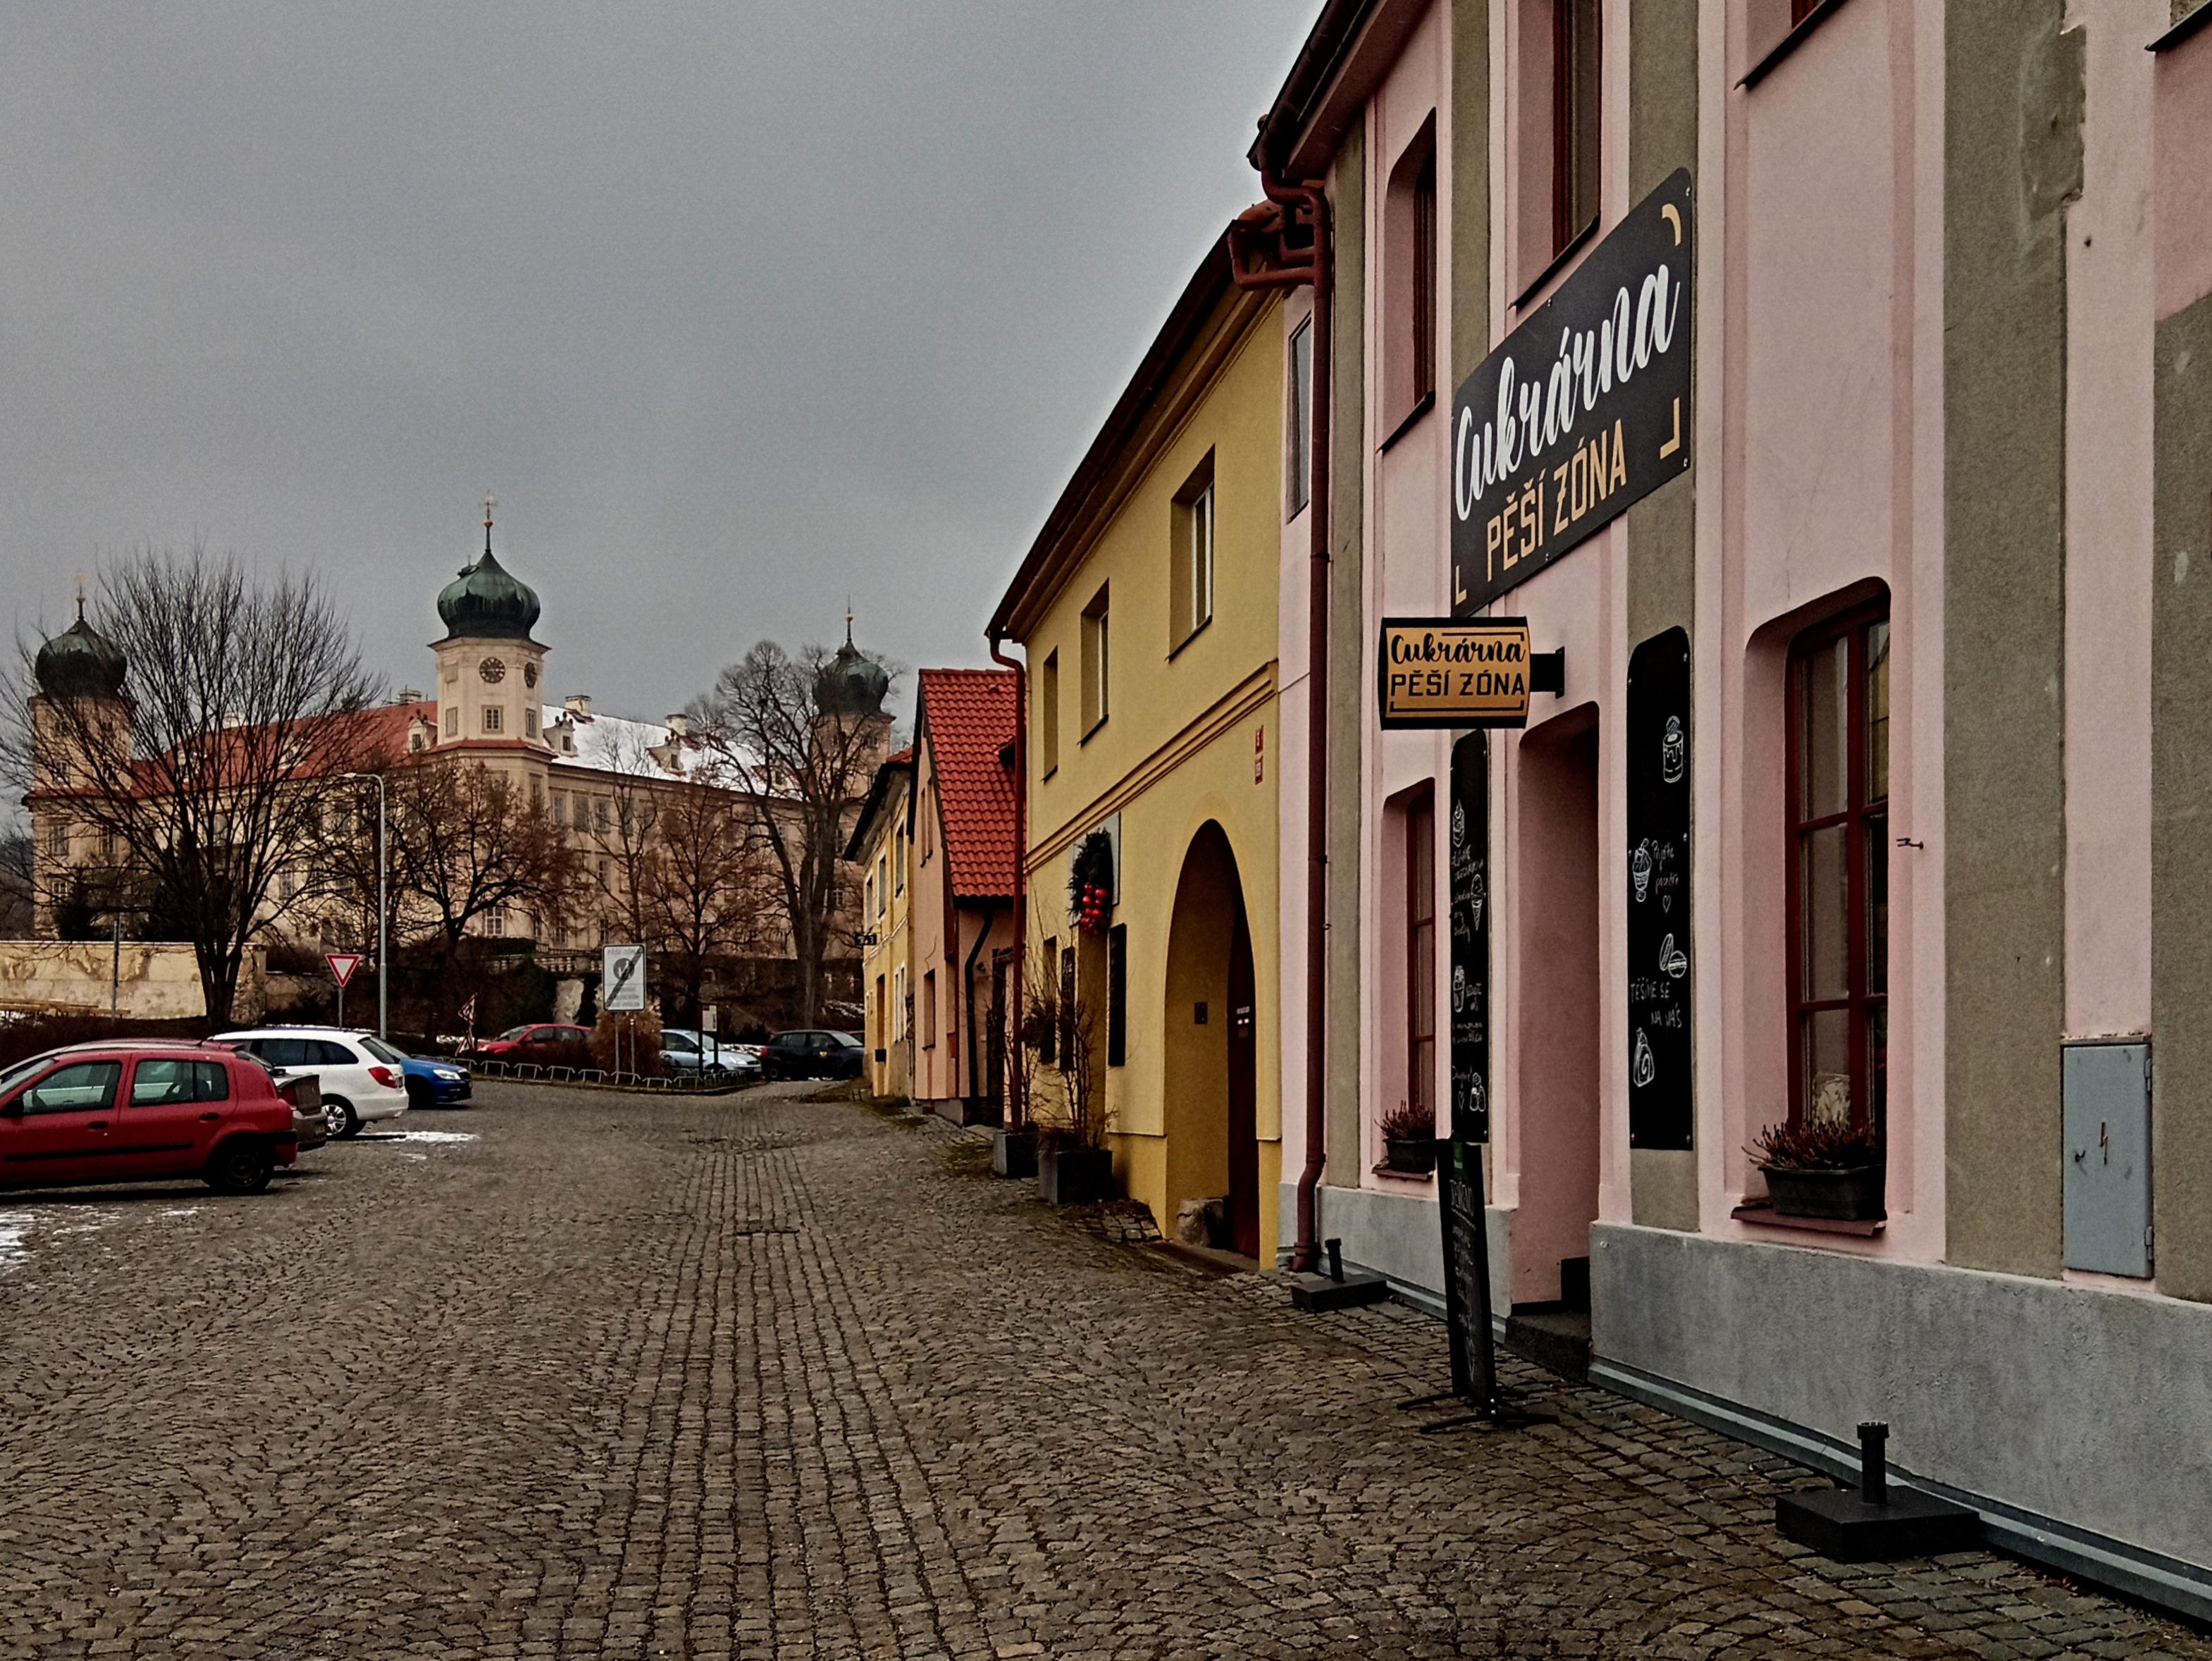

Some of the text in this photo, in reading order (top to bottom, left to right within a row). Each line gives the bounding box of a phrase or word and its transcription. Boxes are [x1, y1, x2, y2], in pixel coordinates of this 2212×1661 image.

[1455, 264, 1681, 521] Cukrárna
[1487, 419, 1627, 582] PĚŠÍ ZÓNA
[1391, 633, 1526, 665] Cukrárna
[1390, 669, 1525, 696] PĚŠÍ ZÓNA
[1660, 982, 1670, 999] SE
